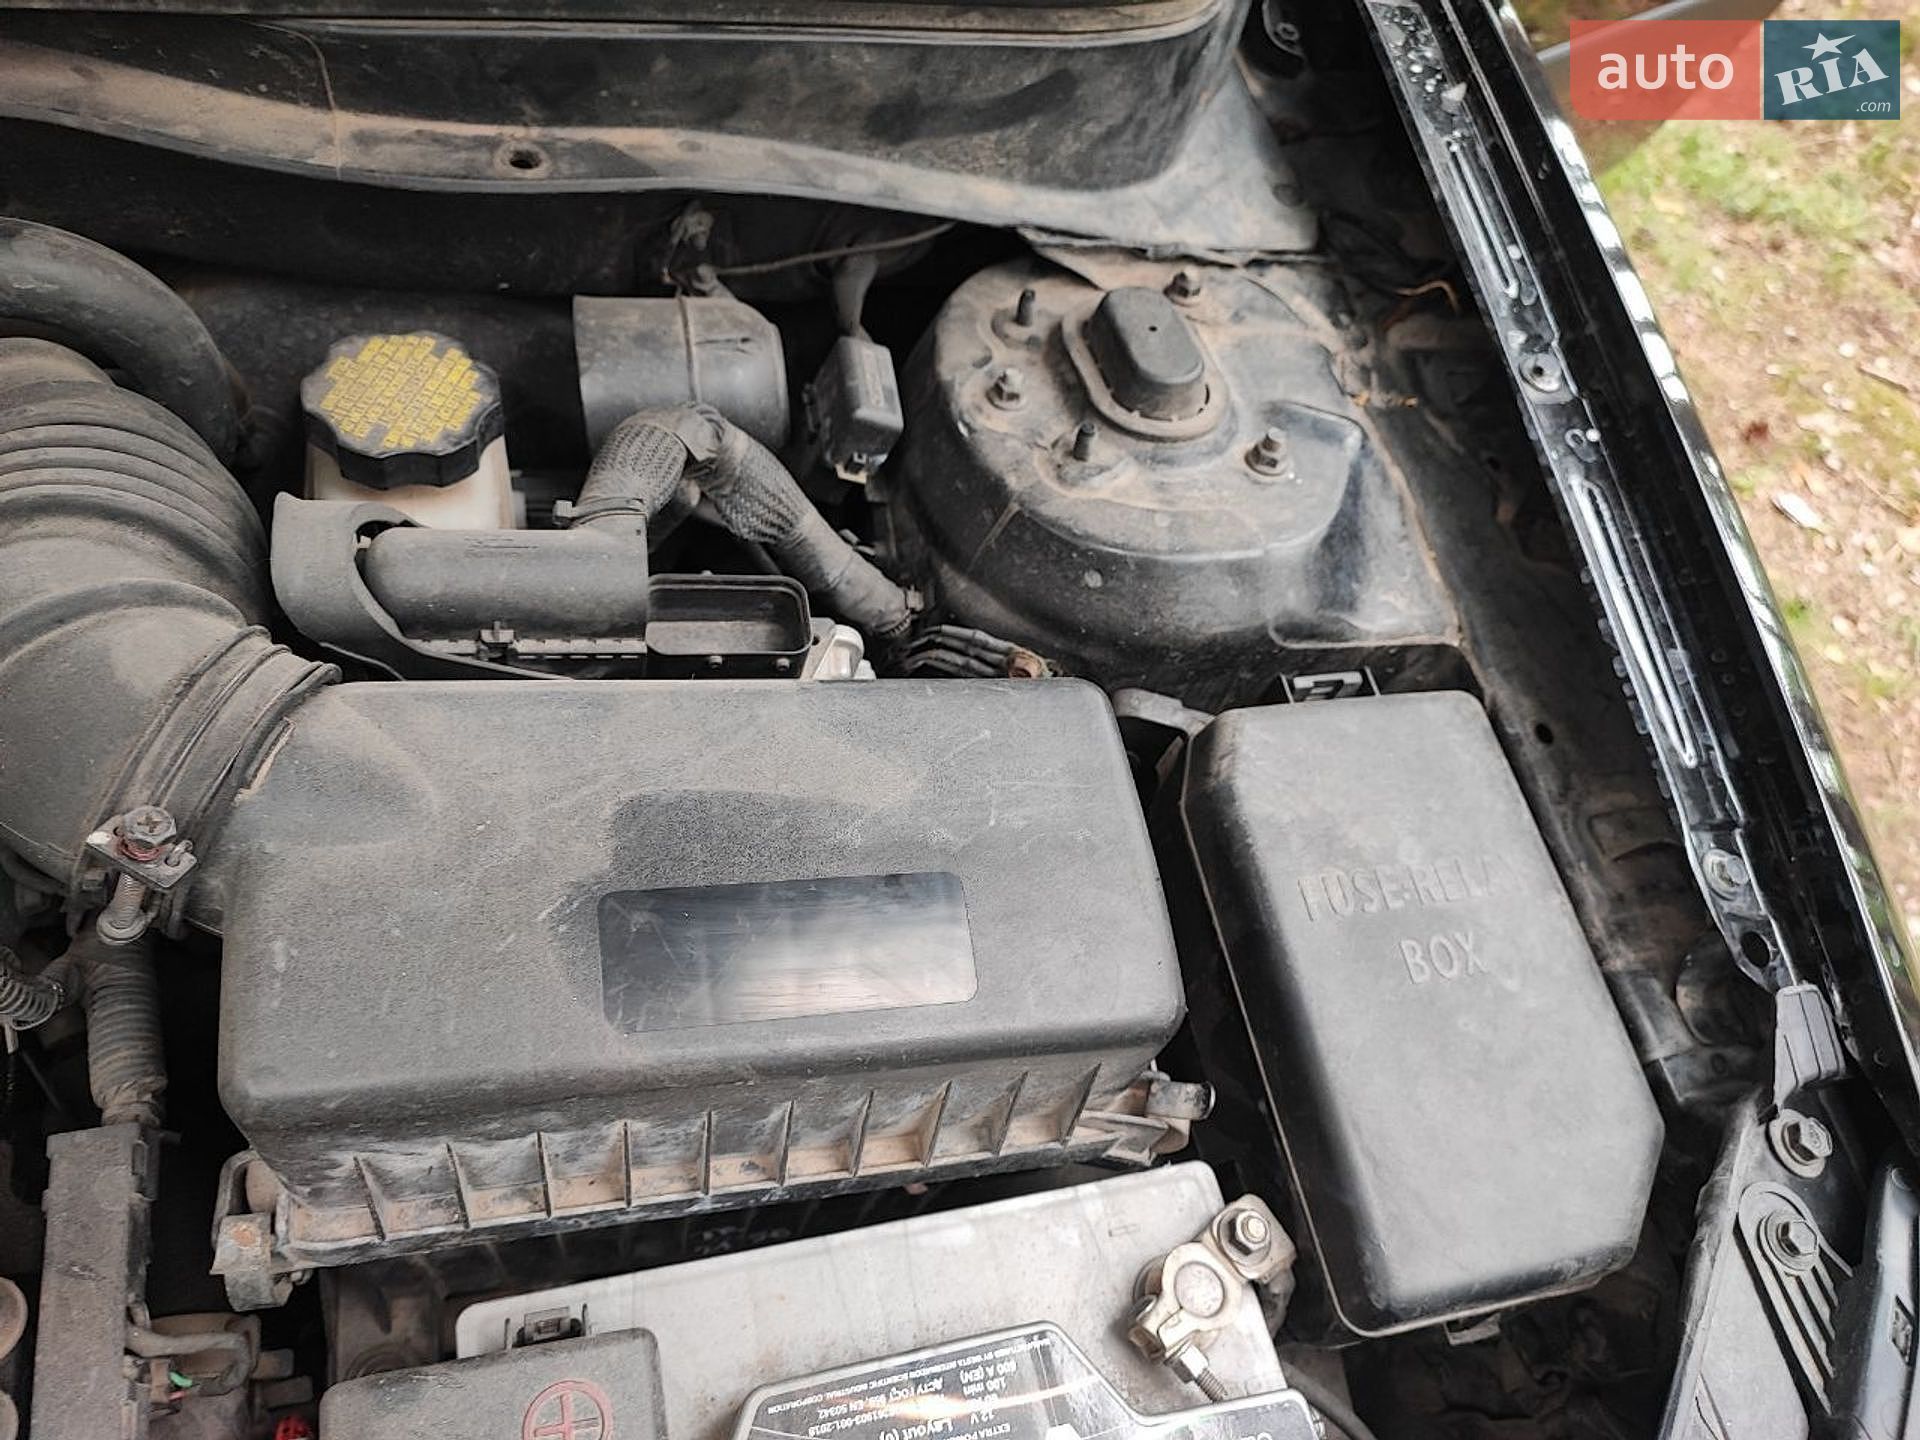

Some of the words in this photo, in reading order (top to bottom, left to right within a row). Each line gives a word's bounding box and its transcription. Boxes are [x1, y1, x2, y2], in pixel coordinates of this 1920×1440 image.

[1400, 931, 1488, 985] BOX
[902, 1418, 954, 1440] Layout
[978, 1422, 1011, 1438] EXTRA
